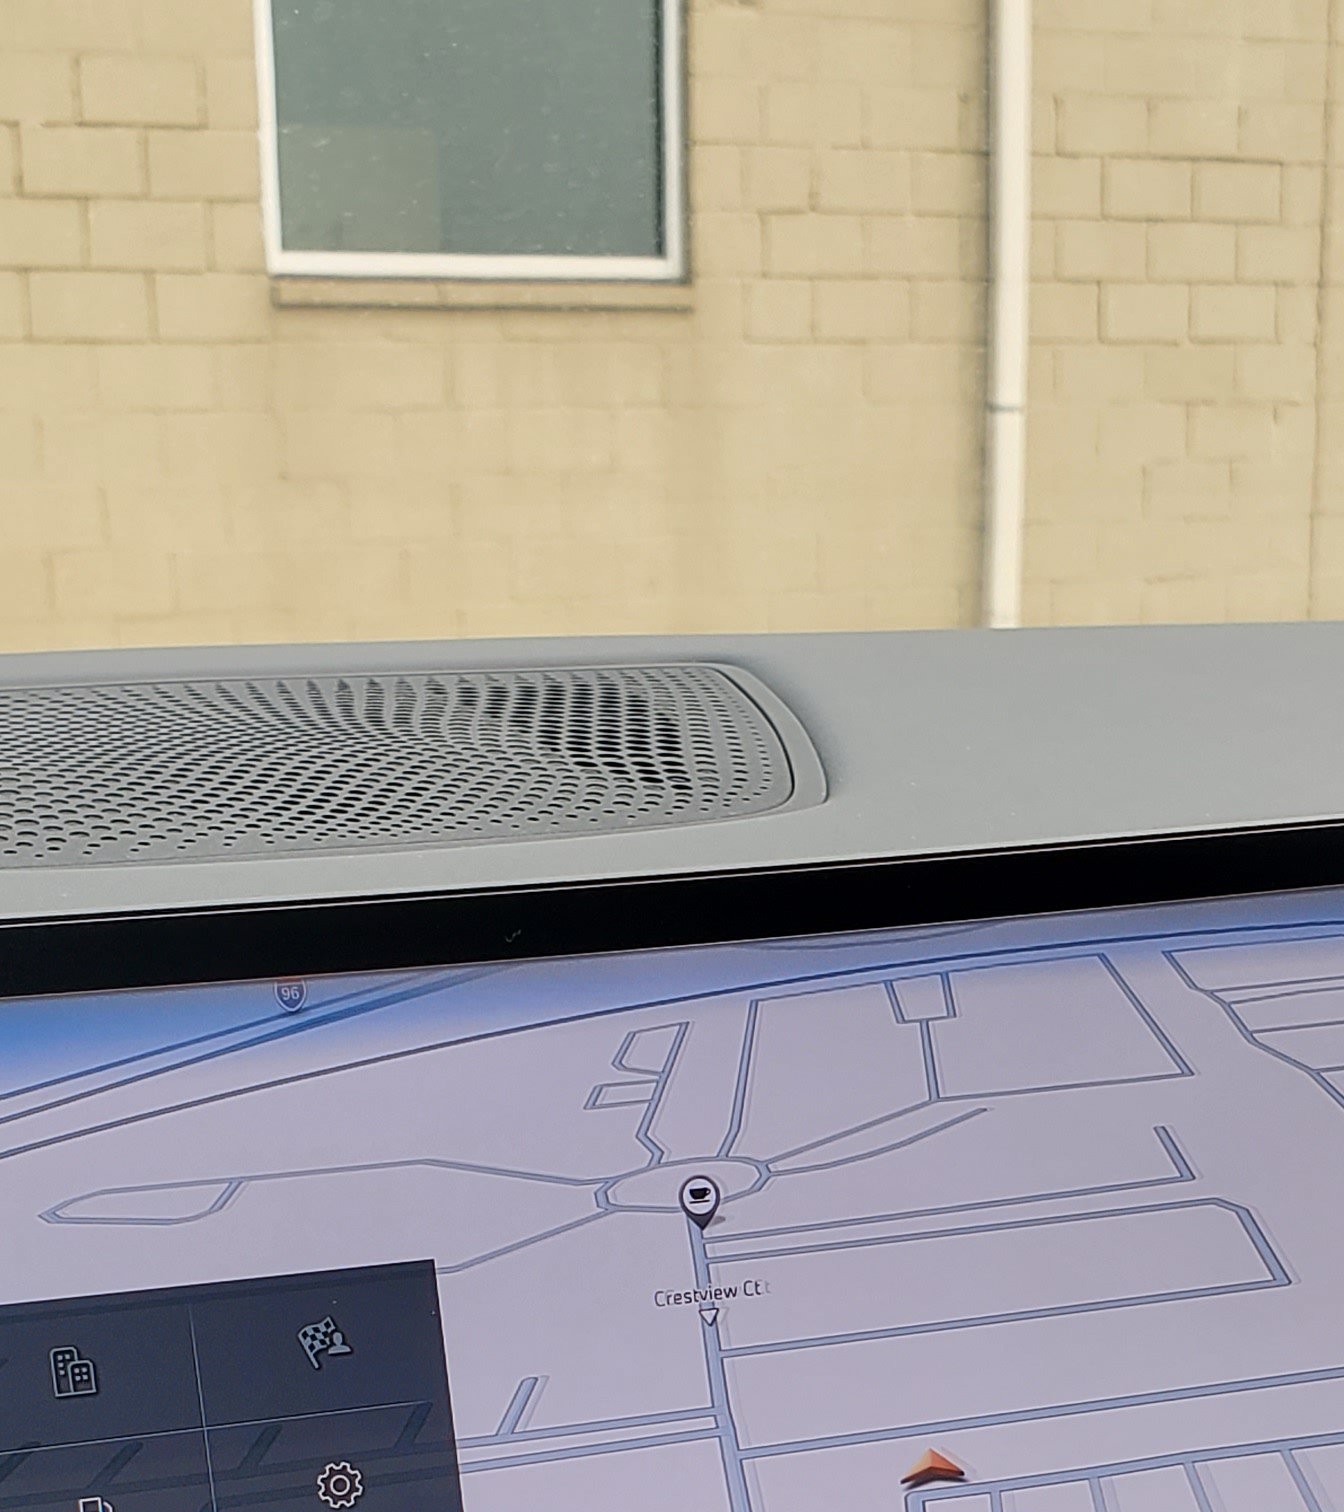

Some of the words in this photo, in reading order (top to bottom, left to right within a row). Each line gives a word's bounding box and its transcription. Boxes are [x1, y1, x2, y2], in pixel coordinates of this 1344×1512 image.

[281, 986, 300, 1000] 96
[654, 1283, 738, 1307] Crestview
[743, 1280, 762, 1296] Ct
